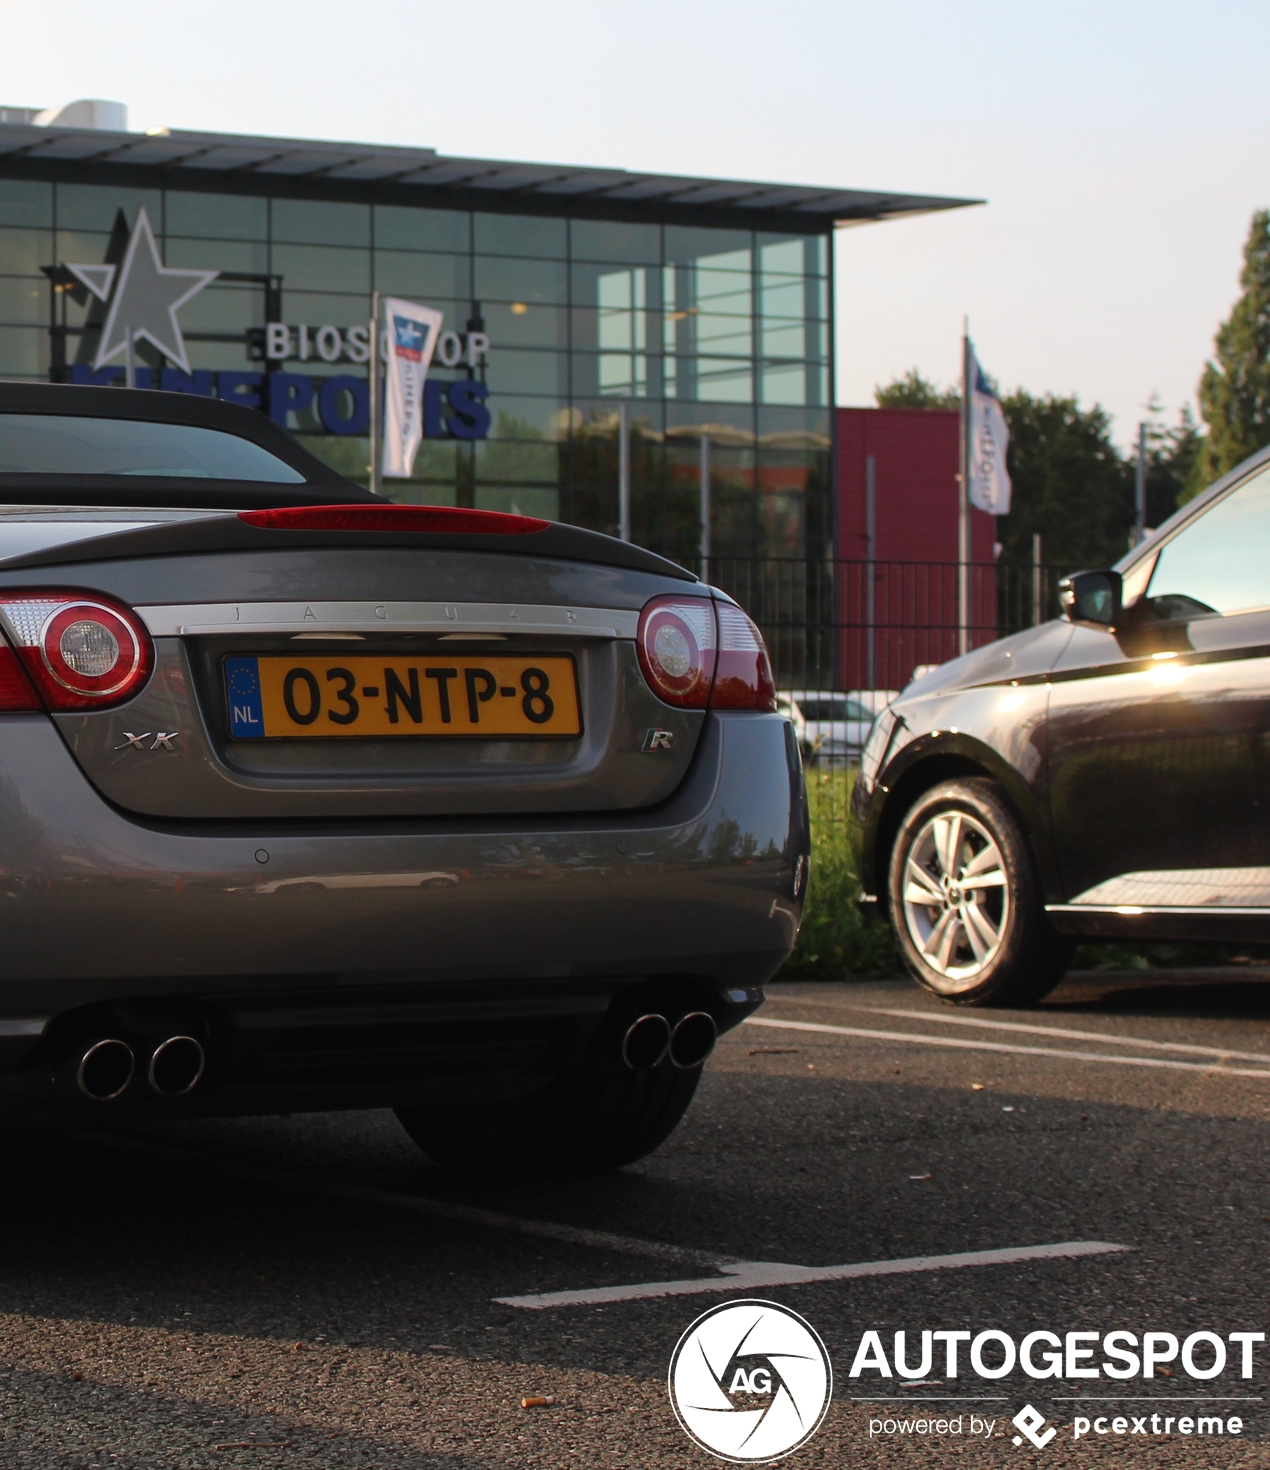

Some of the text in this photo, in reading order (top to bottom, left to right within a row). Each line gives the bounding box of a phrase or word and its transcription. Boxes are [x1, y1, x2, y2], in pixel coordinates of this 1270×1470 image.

[266, 322, 490, 366] BIOSOP
[71, 364, 491, 439] EPOIS
[235, 605, 577, 624] JAGUAR
[283, 667, 554, 726] 03-NTP-8
[233, 705, 259, 724] NL
[114, 731, 179, 751] XK
[648, 730, 673, 749] R
